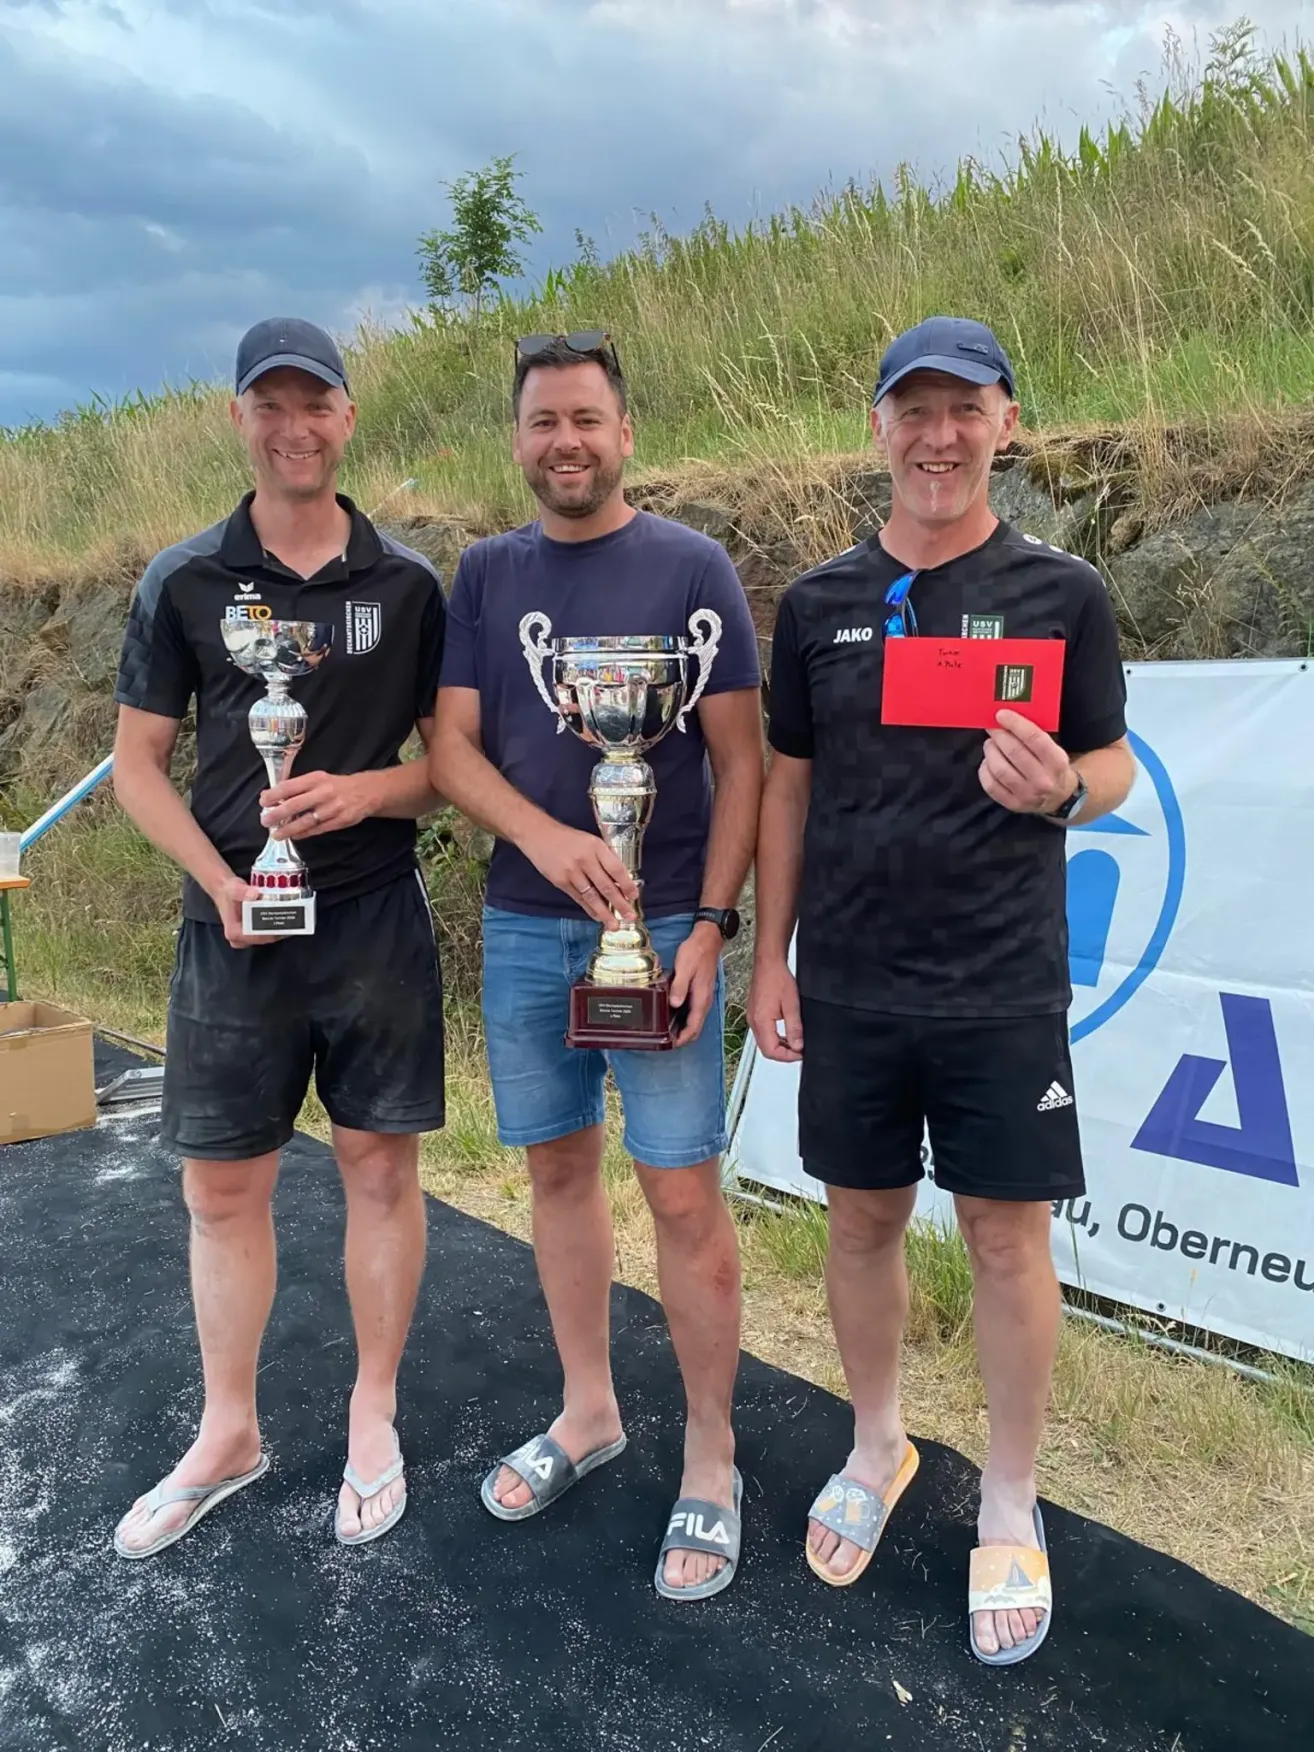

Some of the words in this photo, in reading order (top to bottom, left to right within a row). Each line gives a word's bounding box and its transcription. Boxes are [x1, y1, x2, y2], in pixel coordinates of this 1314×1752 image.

[225, 605, 272, 620] BETO
[972, 620, 993, 628] USV
[833, 627, 872, 643] JAKO
[1036, 1095, 1073, 1112] adidas
[1116, 1202, 1314, 1292] Oberneu
[667, 1512, 731, 1545] FILA
